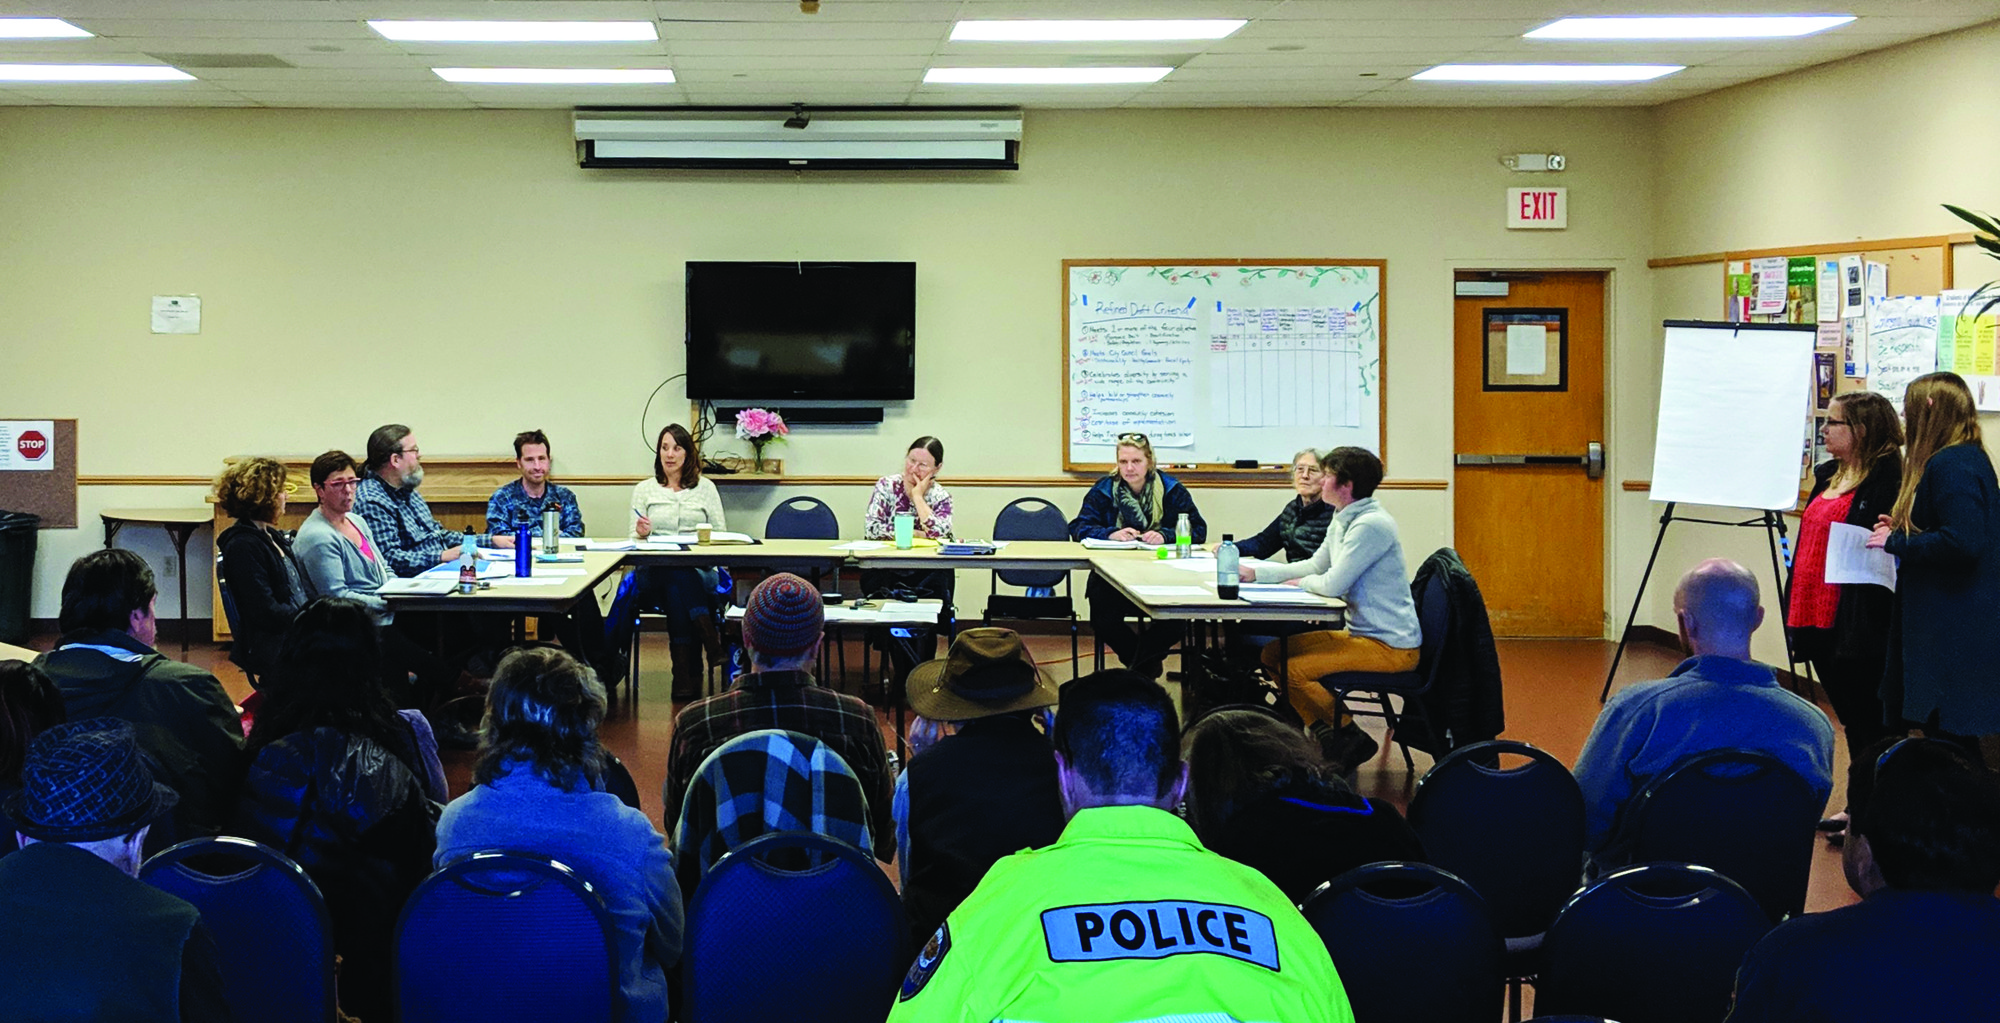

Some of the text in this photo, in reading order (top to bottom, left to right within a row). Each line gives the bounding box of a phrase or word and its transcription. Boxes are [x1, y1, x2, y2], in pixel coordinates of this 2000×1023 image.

[1521, 192, 1558, 220] EXIT
[1095, 301, 1127, 314] Refined
[20, 440, 45, 449] STOP
[1075, 907, 1252, 955] POLICE
